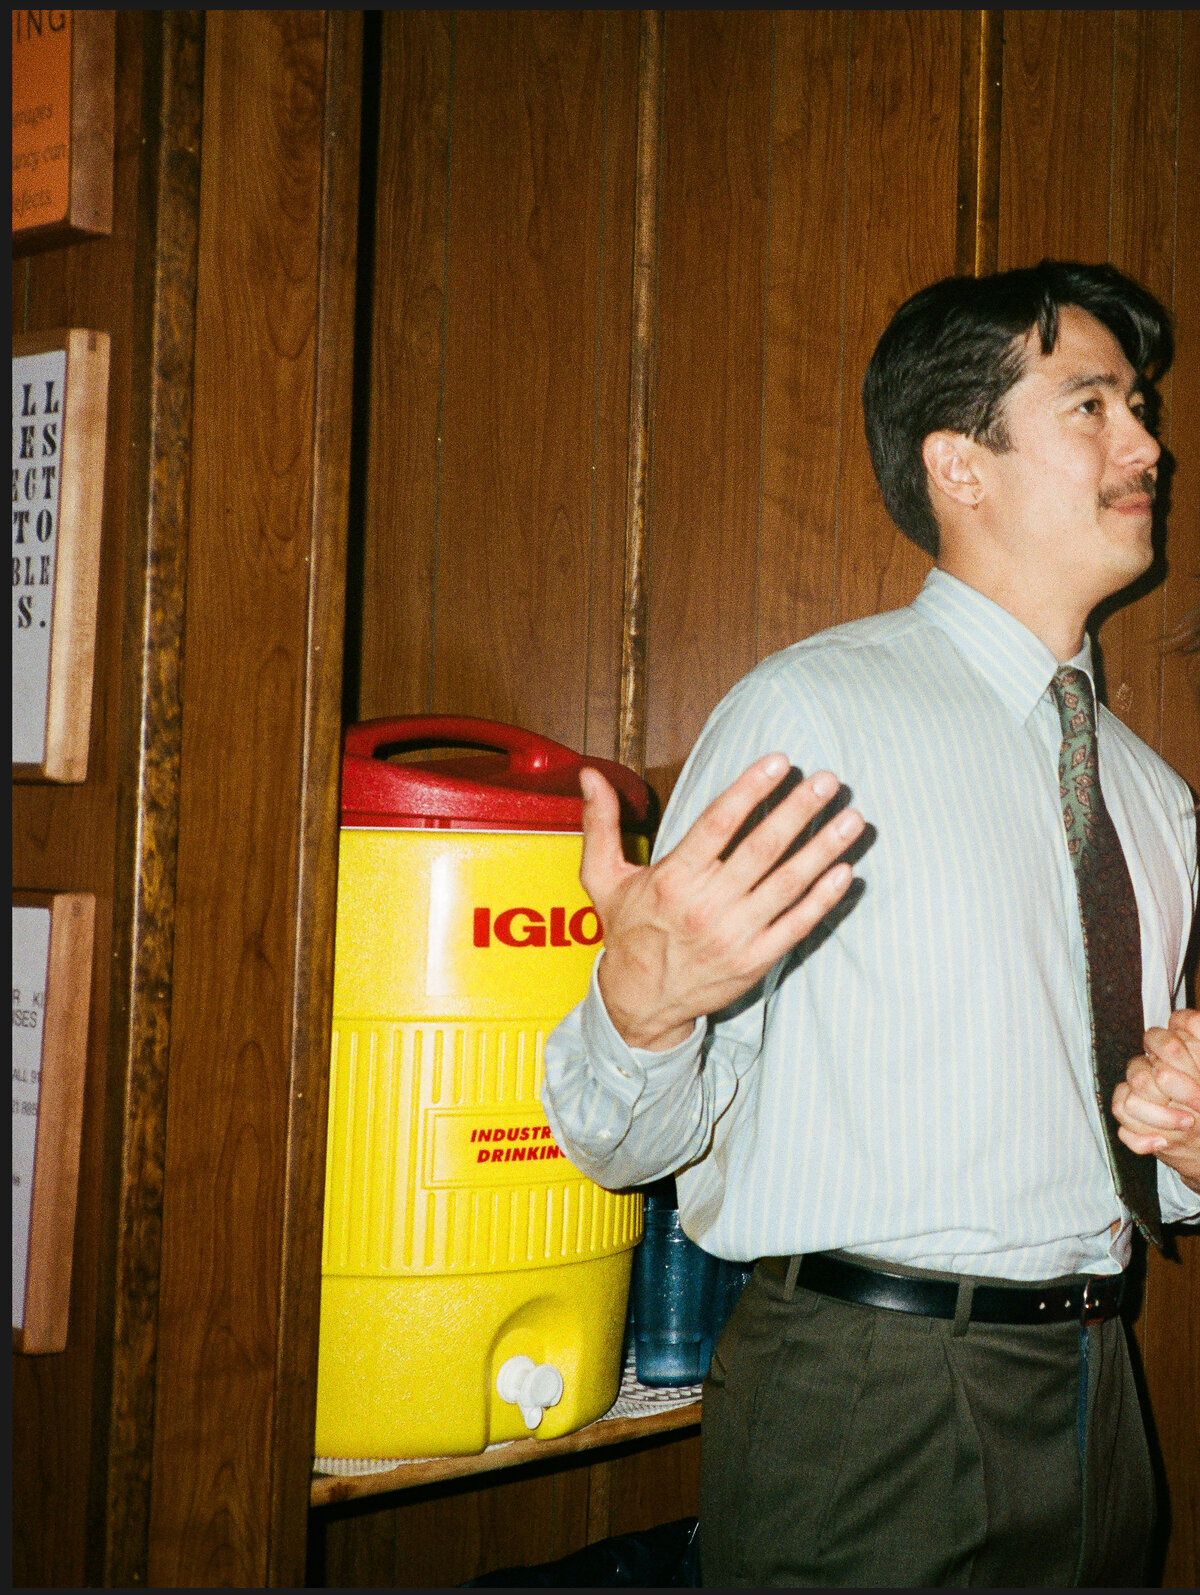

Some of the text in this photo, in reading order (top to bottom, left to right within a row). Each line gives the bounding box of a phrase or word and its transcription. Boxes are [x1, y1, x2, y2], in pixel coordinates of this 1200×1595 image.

[21, 380, 58, 417] LL
[19, 423, 57, 459] ES
[13, 509, 52, 544] TO
[12, 1009, 37, 1028] SES
[470, 1126, 554, 1143] INDUSTR
